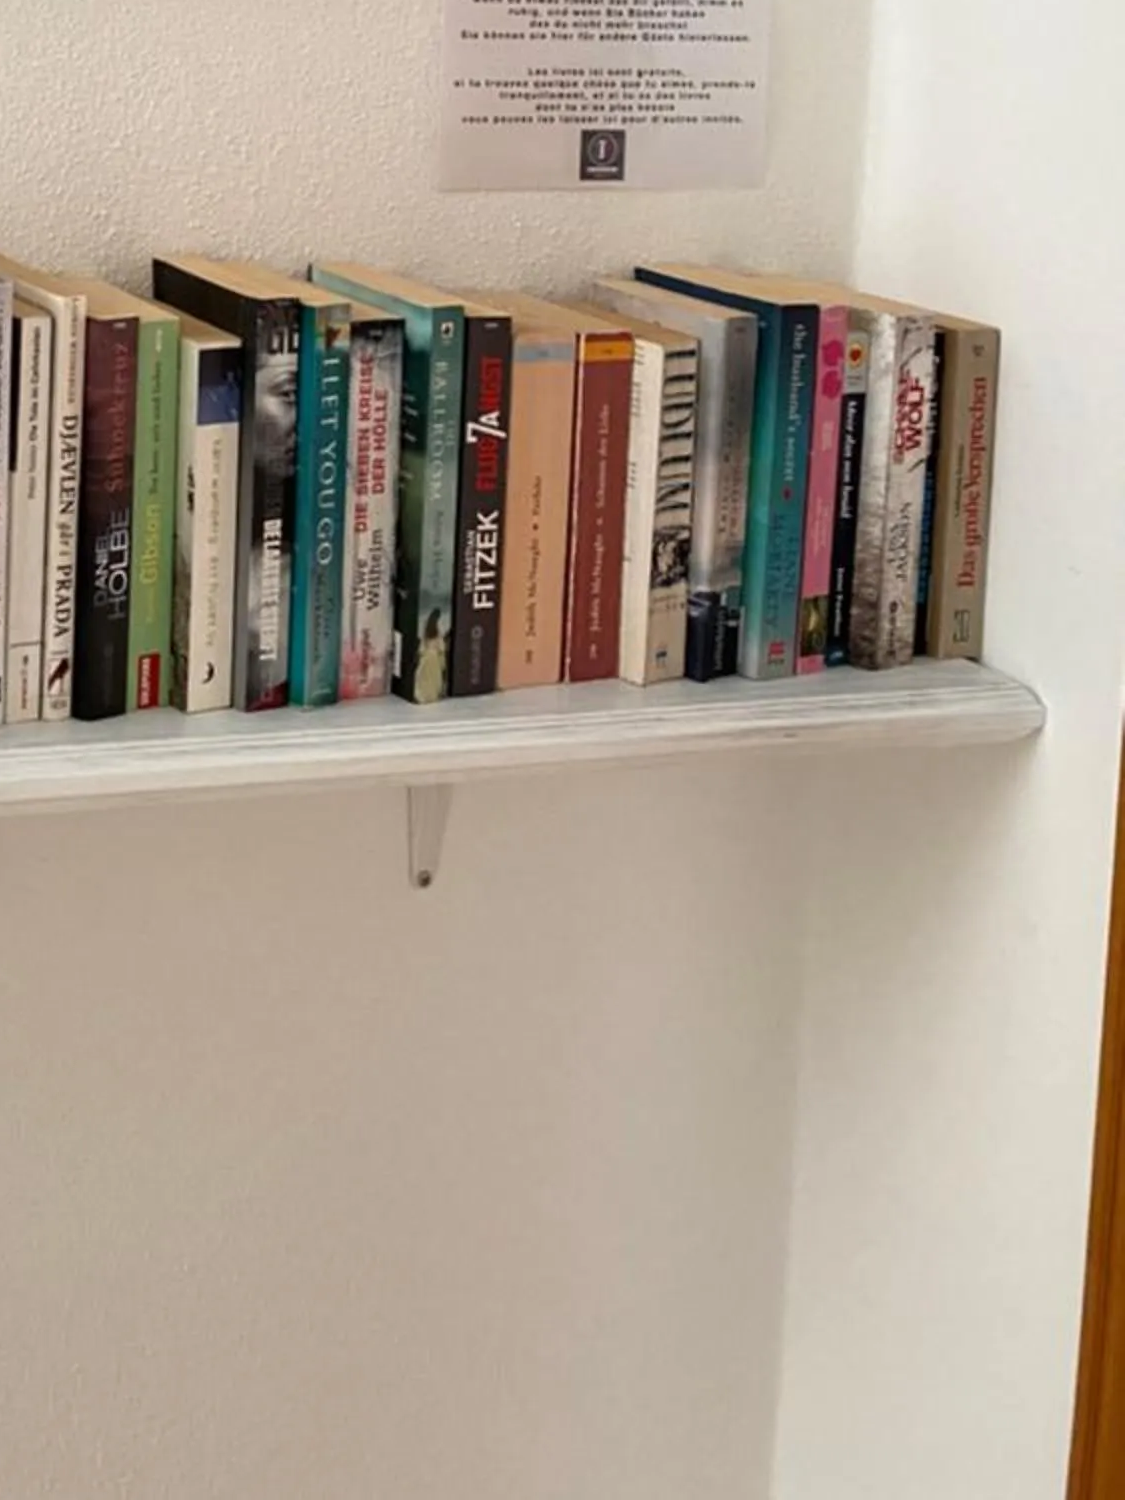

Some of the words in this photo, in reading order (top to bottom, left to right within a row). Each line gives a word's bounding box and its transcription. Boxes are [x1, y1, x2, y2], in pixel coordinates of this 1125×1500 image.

[792, 322, 808, 351] the
[320, 375, 339, 431] LET
[359, 350, 374, 422] KREISE
[787, 353, 806, 433] husband's
[355, 428, 371, 497] SIEBEN
[430, 360, 449, 501] BALLROOM
[783, 436, 797, 482] secret
[963, 376, 988, 489] Versprechen
[317, 440, 338, 509] YOU
[372, 457, 386, 496] DER
[139, 503, 161, 585] Gibson
[262, 518, 282, 541] DE
[316, 517, 335, 565] GO
[354, 503, 369, 534] DIE
[94, 536, 110, 607] DANIEL
[108, 508, 129, 620] HOLBE
[353, 558, 369, 600] Uwe
[367, 529, 383, 611] Wilhelm
[463, 529, 475, 595] SEBASTIAN
[473, 509, 500, 610] FITZEK
[956, 553, 976, 588] Das
[54, 564, 74, 638] PRADA
